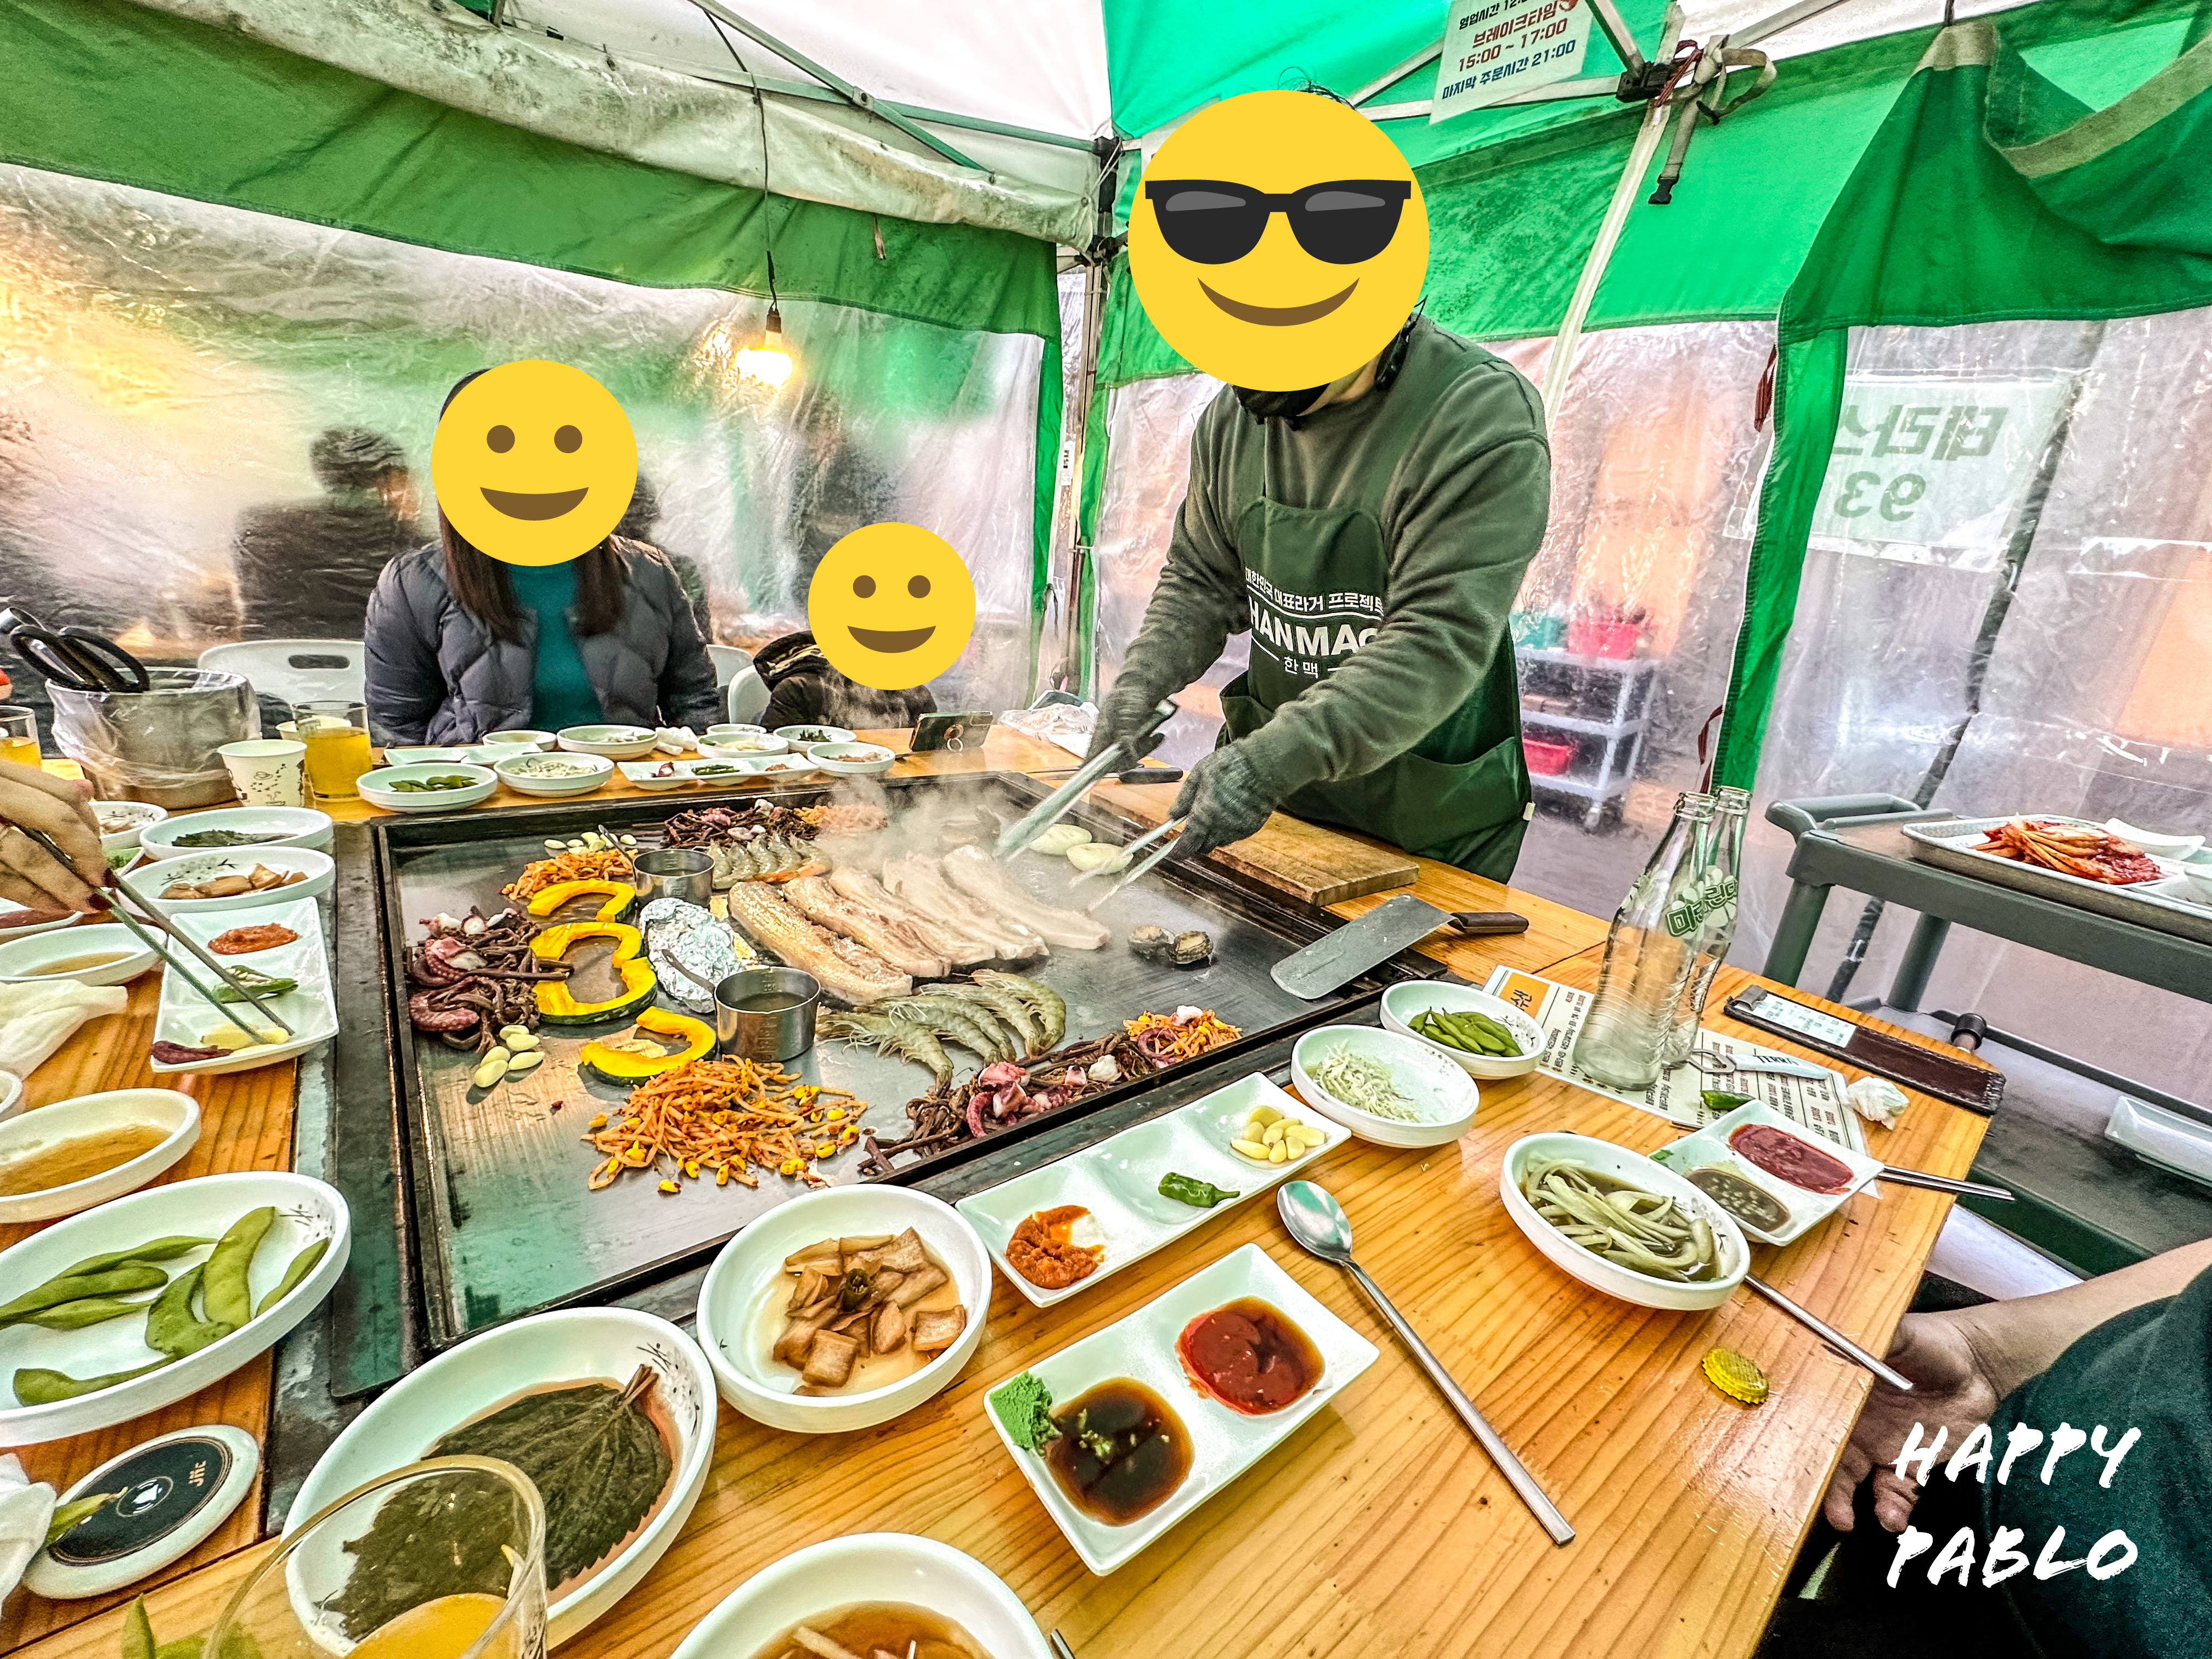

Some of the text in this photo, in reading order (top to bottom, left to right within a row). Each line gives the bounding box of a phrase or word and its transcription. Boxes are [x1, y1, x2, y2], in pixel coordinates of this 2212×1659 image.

[1459, 3, 1499, 30] 영업시간
[1472, 1, 1558, 48] 브레이크타임
[1442, 40, 1577, 100] 마지막 주문시간 21:00
[1459, 44, 1502, 72] 15:00
[1521, 18, 1568, 49] 17:00
[1244, 567, 1384, 617] 대한민국 대표라거 프로젝트
